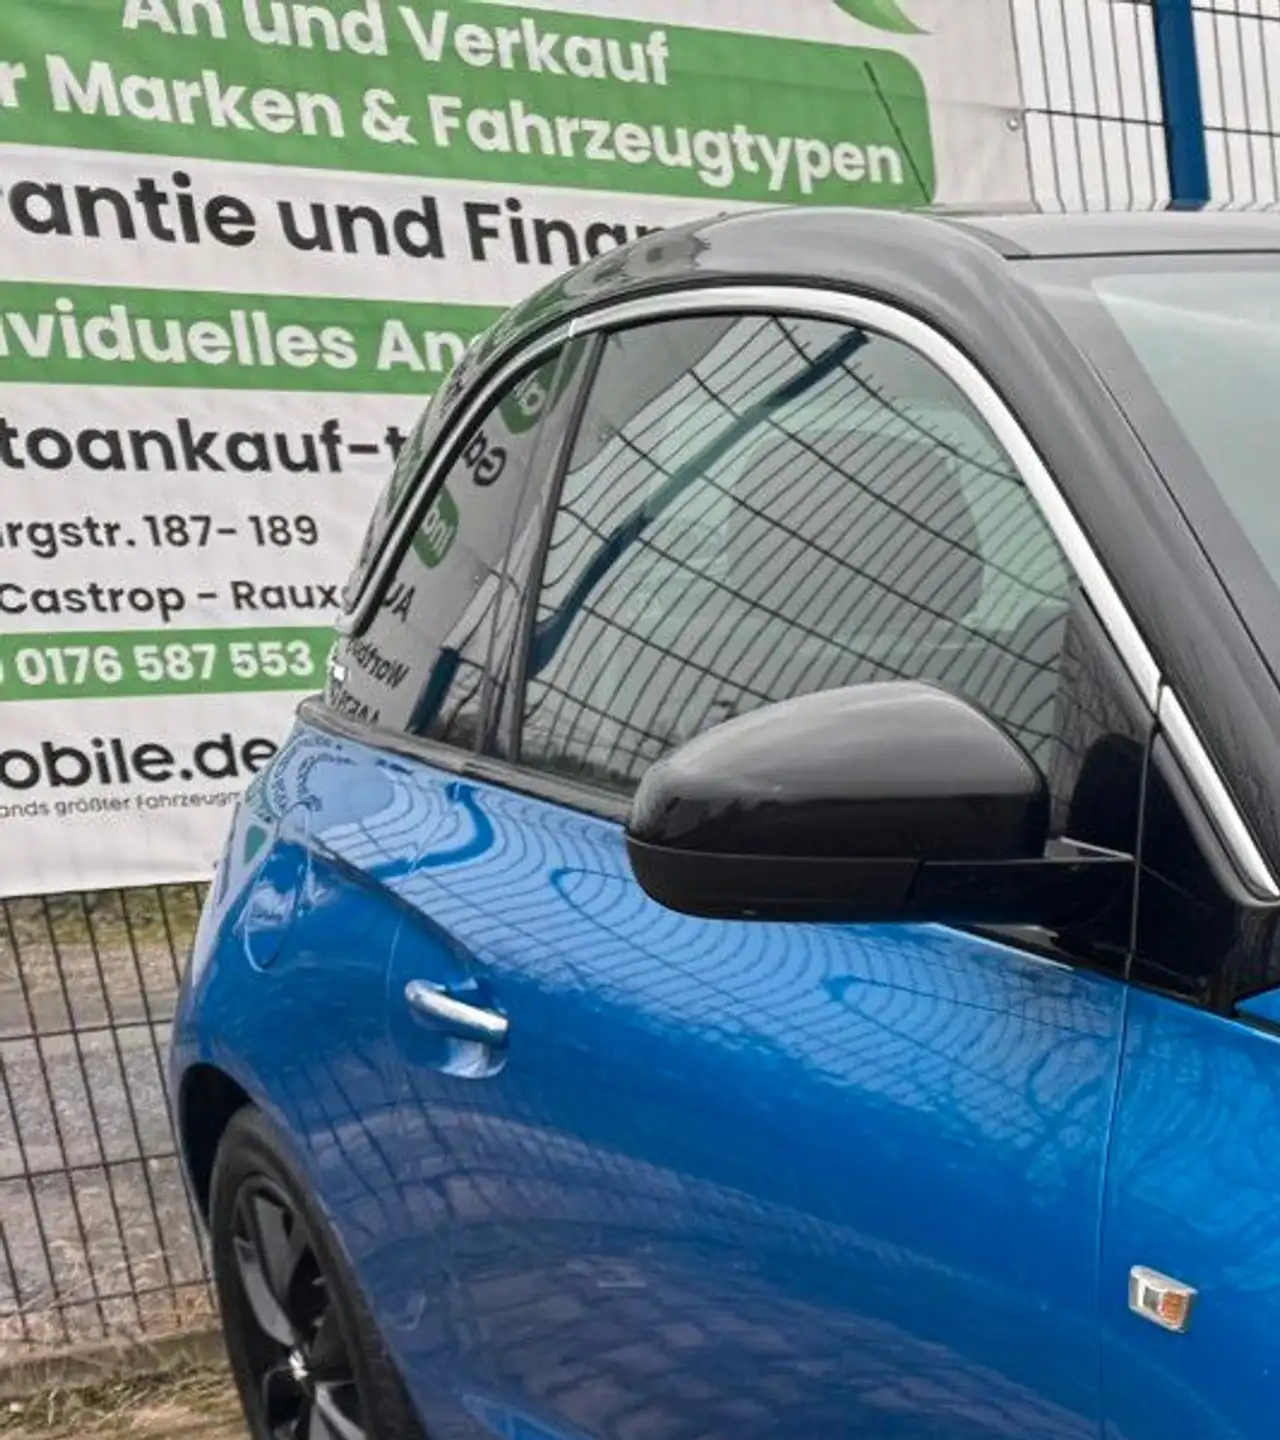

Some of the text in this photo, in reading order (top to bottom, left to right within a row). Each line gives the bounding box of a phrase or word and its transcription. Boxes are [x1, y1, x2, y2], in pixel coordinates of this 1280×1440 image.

[121, 0, 669, 86] An und Verkauf
[45, 54, 345, 138] Marken
[362, 88, 418, 146] &
[427, 93, 903, 194] Fahrzeugtypen
[0, 170, 665, 266] antie und Fina
[377, 318, 481, 373] An
[0, 515, 137, 559] rgstr.
[248, 514, 319, 546] 189
[0, 582, 186, 623] Castrop
[15, 640, 314, 686] 0176 587 553
[0, 732, 279, 790] obile.de
